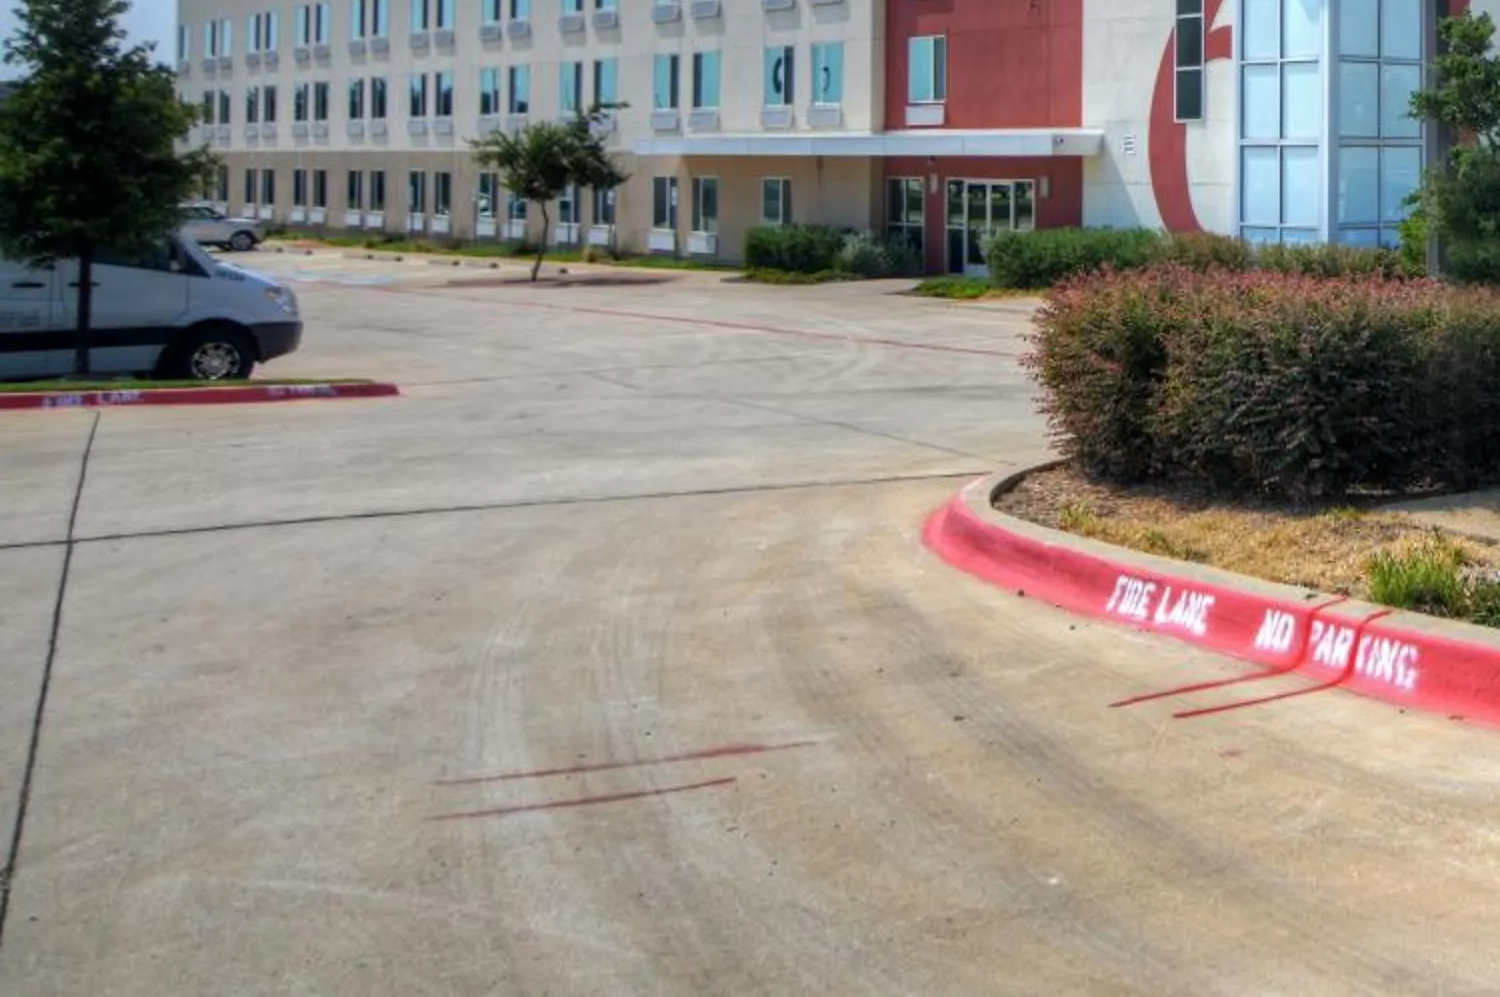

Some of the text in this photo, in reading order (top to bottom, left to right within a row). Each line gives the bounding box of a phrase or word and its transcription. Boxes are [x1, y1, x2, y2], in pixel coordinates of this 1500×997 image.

[1105, 575, 1216, 636] FIRE LANE
[1254, 608, 1296, 653] NO
